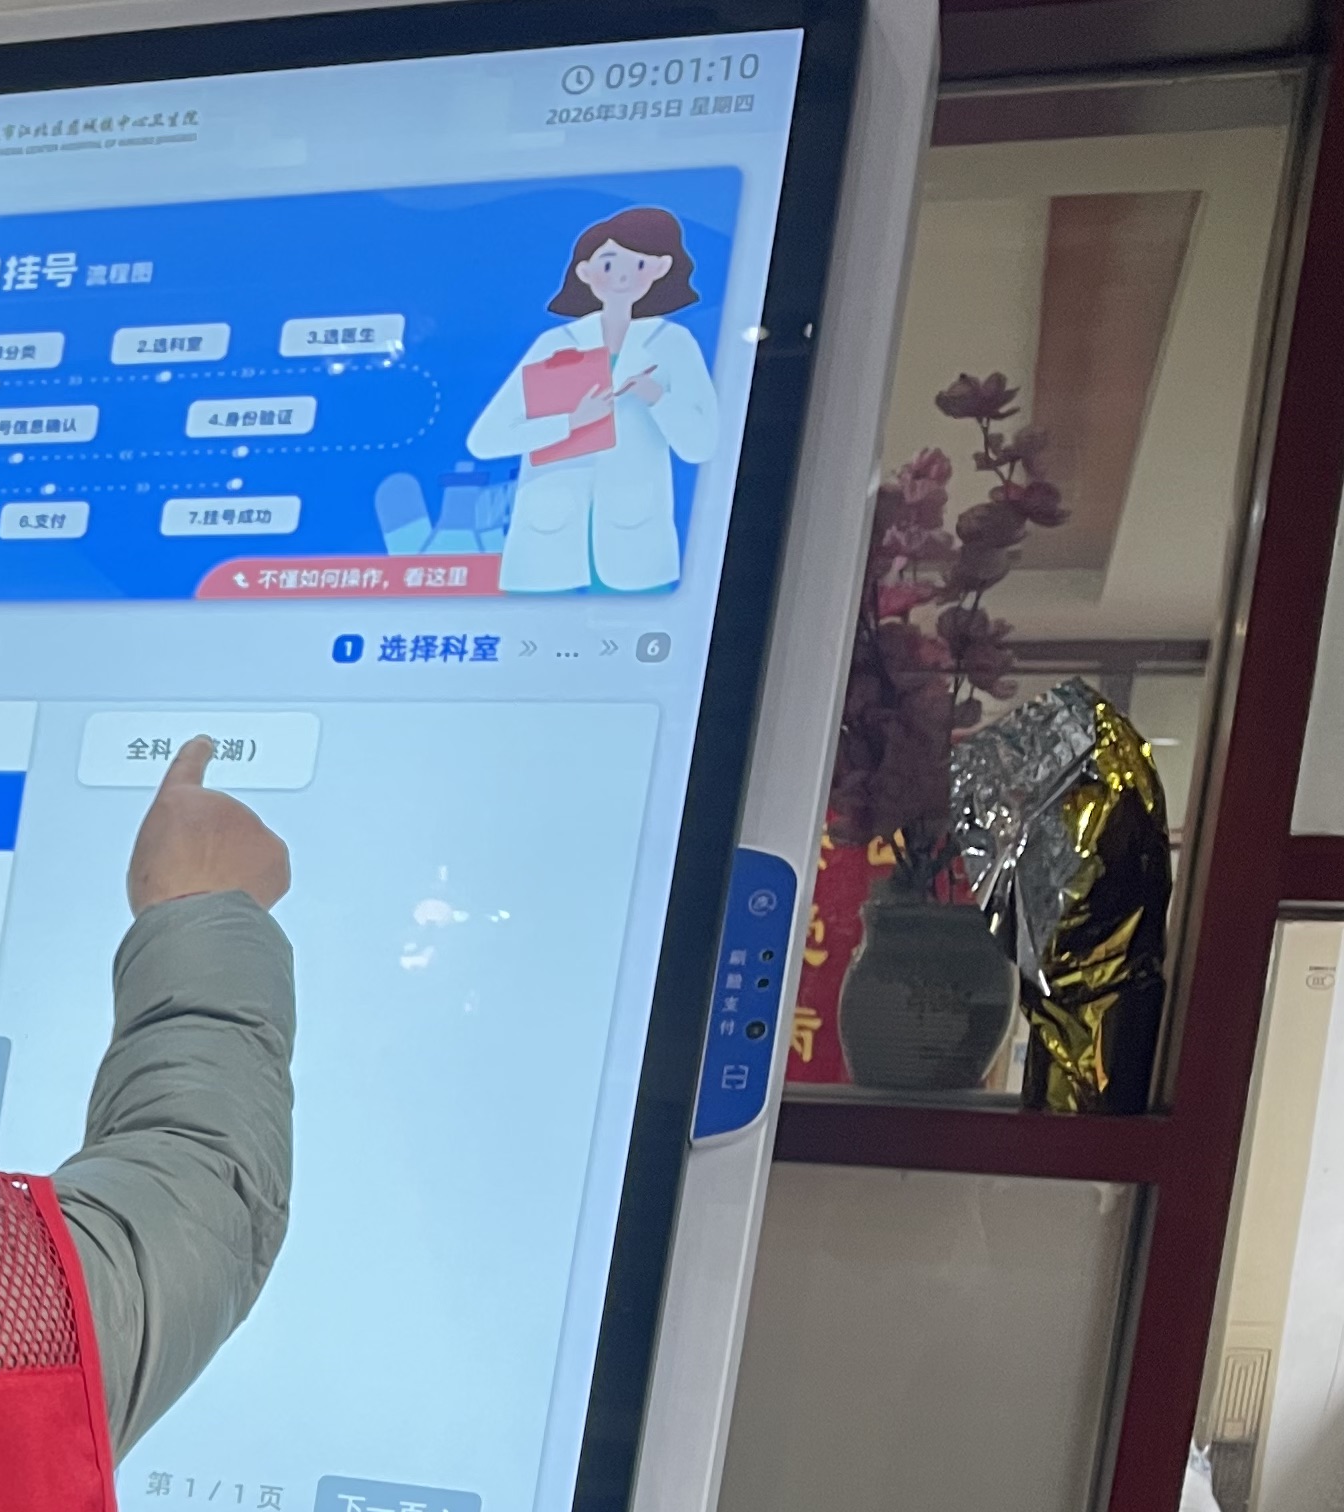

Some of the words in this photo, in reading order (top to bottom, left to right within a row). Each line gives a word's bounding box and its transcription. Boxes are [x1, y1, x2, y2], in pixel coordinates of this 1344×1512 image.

[605, 53, 760, 90] 09:01:10
[546, 99, 683, 126] 2026年3月5日
[689, 94, 755, 118] 星期四
[19, 512, 67, 530] 6.支付
[188, 508, 272, 526] 7.挂号成功
[377, 634, 501, 664] 选择科室
